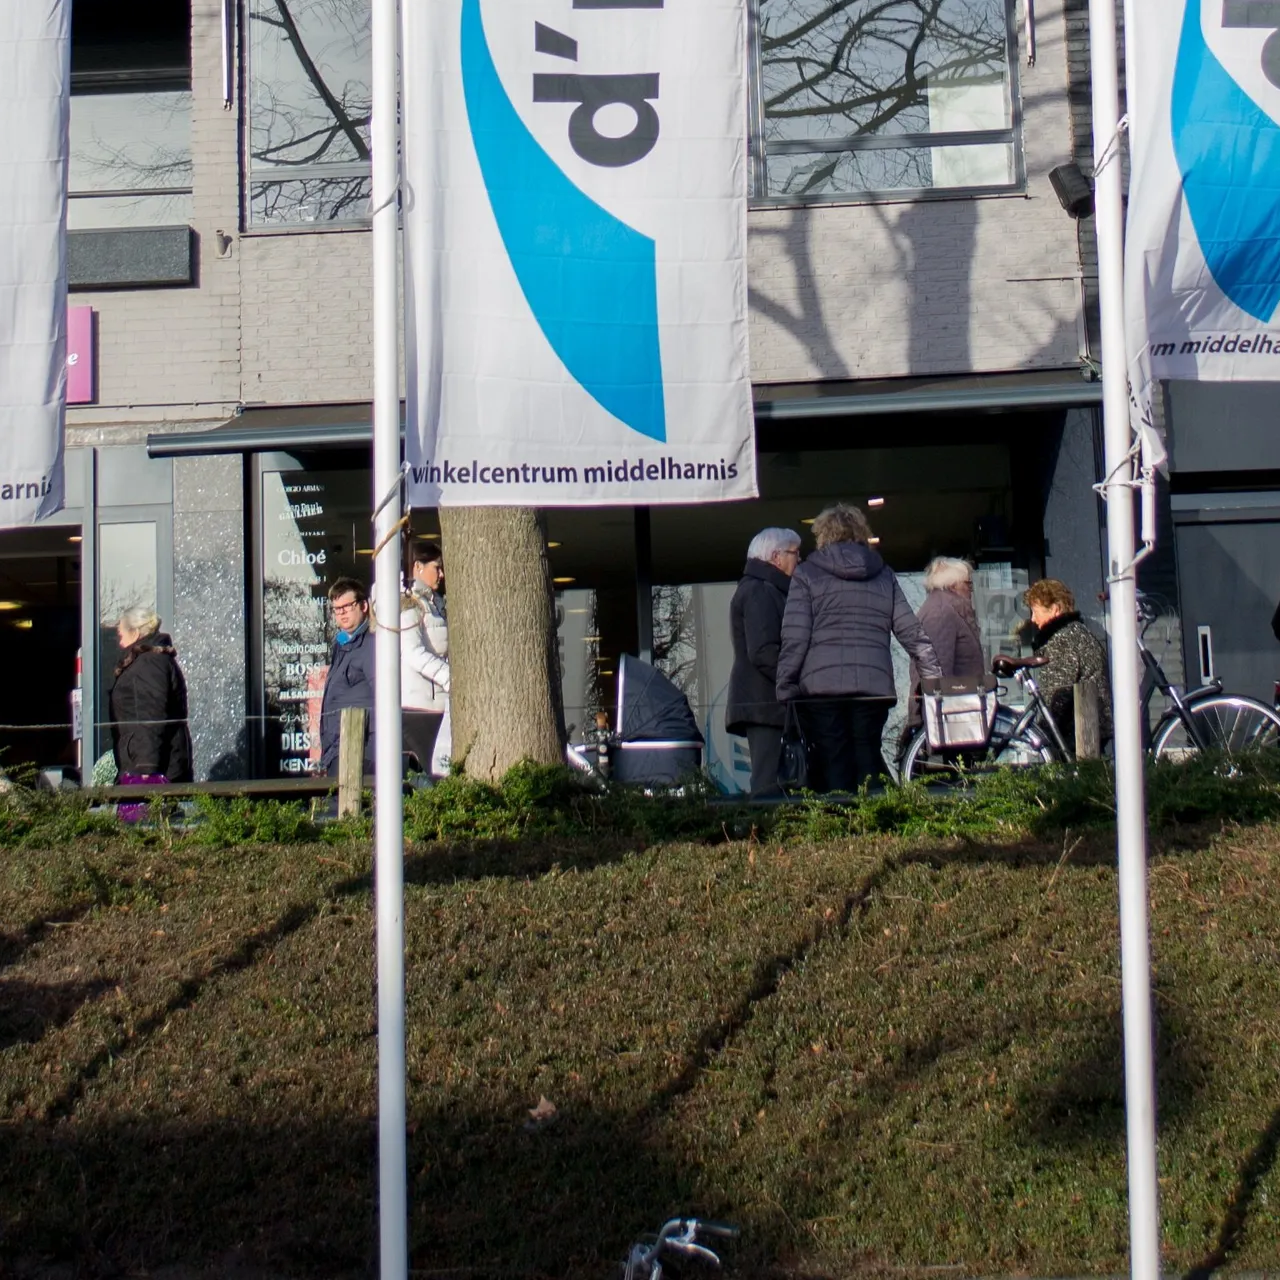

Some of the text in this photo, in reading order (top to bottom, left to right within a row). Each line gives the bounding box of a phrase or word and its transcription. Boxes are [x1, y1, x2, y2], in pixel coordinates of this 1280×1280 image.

[412, 457, 739, 485] winkelcentrum middelharnis
[277, 548, 327, 566] Chloé
[285, 662, 321, 676] BOSS
[281, 732, 320, 751] DIES
